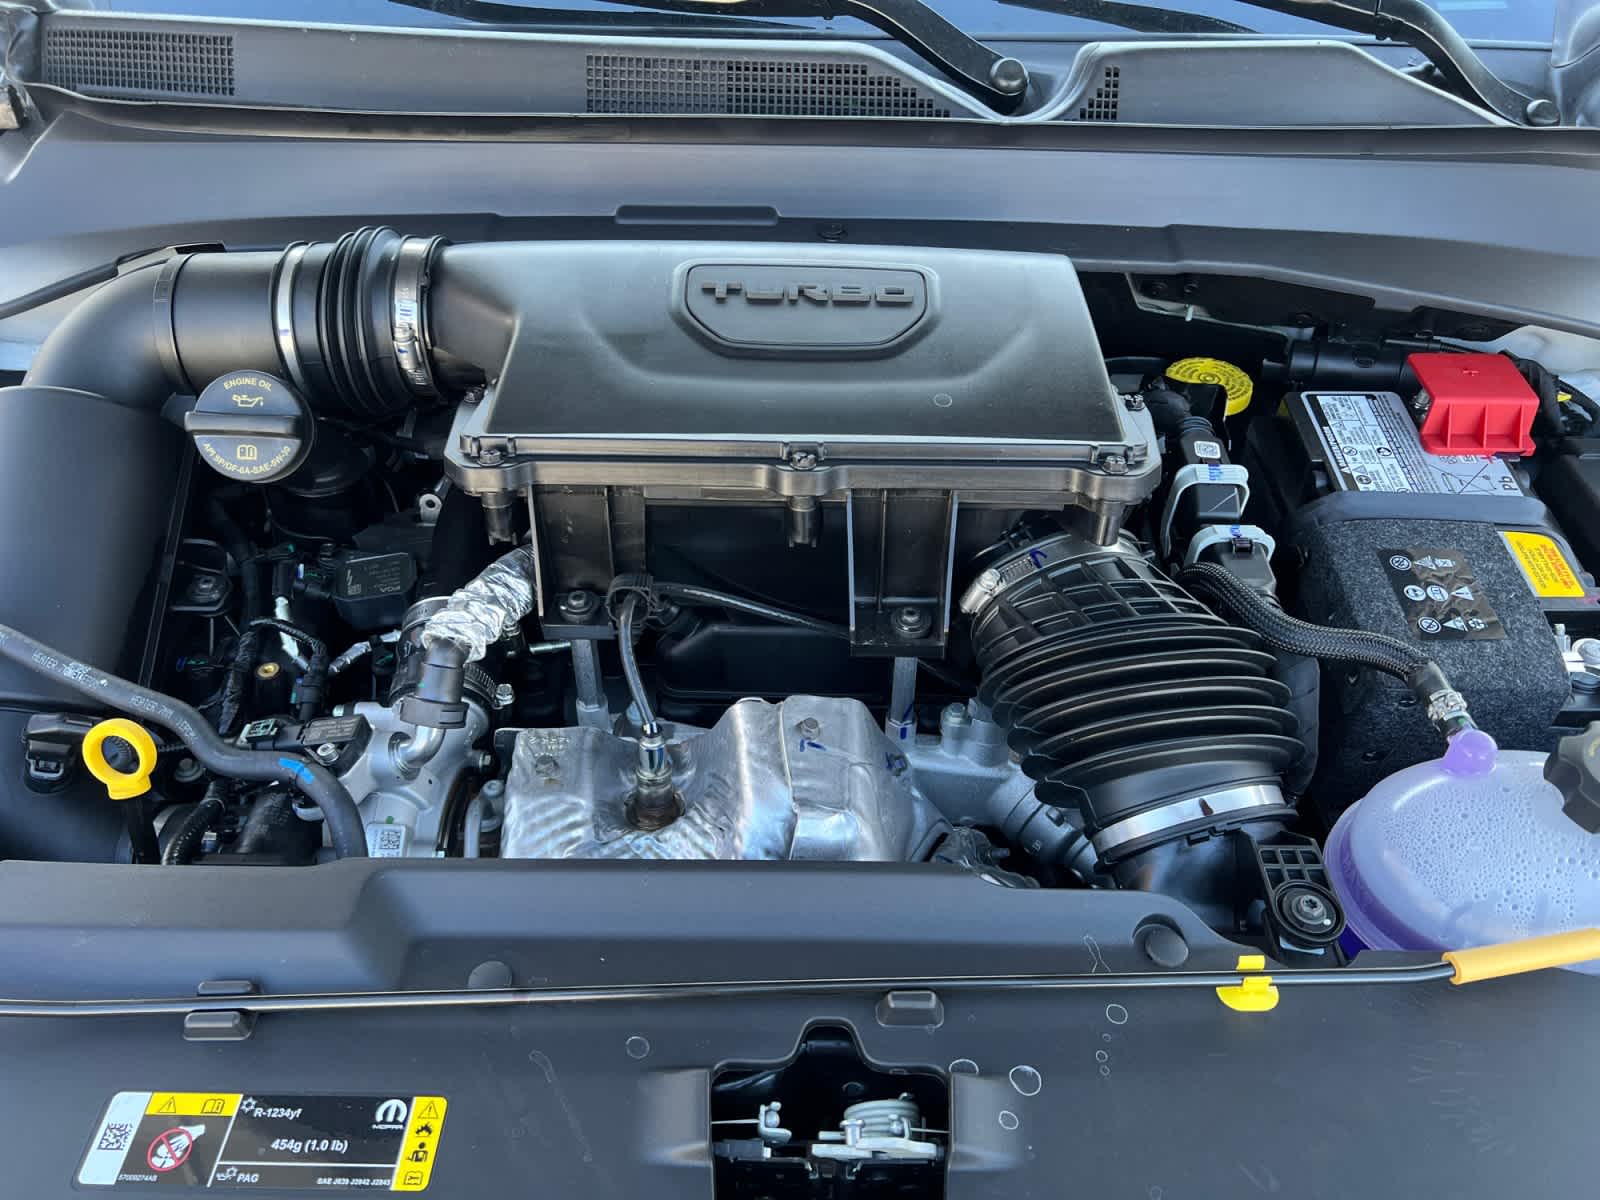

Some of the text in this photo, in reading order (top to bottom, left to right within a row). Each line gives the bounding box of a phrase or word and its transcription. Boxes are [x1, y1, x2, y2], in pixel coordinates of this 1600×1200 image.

[701, 281, 914, 304] TURBO
[223, 377, 272, 392] ENGINE OIL
[1498, 475, 1519, 491] Pb
[253, 1107, 303, 1121] R-1234yf
[270, 1138, 349, 1154] 454g (1.0 lb)
[236, 1173, 260, 1184] PAG
